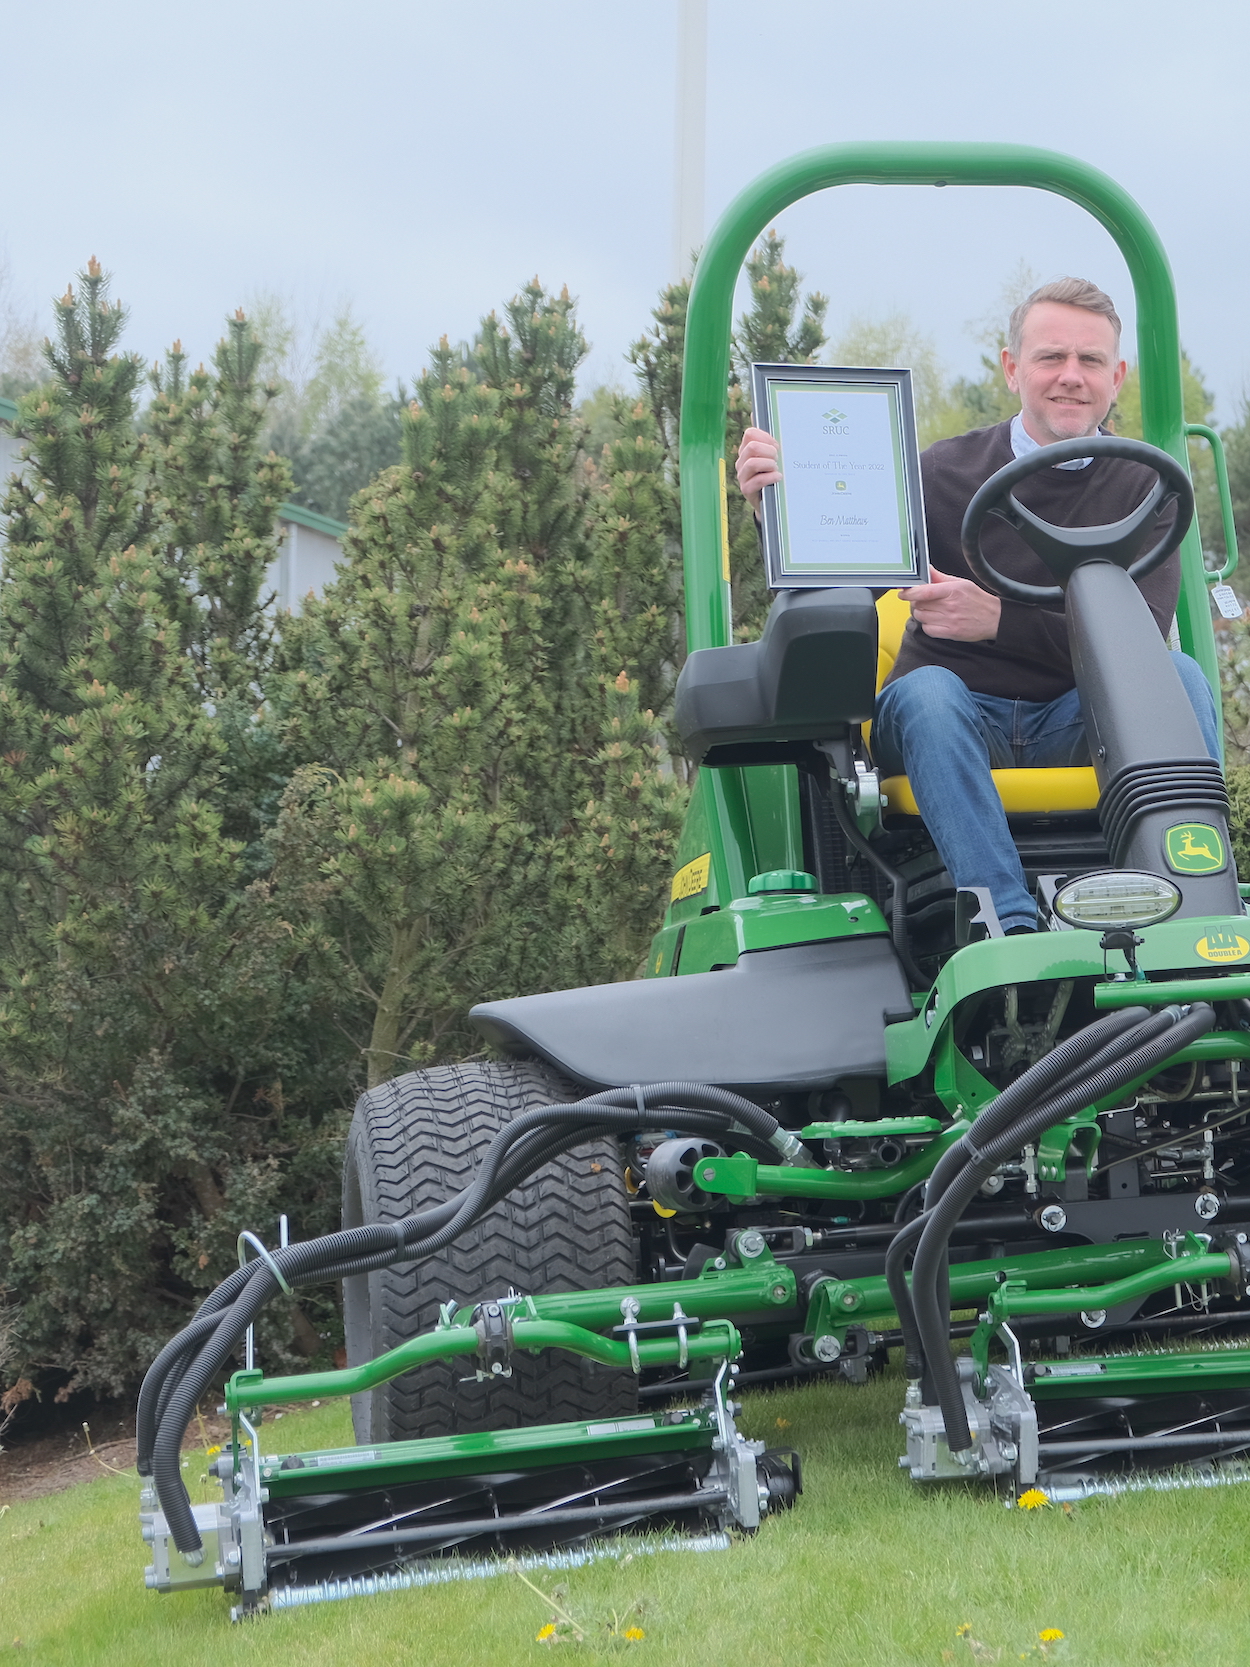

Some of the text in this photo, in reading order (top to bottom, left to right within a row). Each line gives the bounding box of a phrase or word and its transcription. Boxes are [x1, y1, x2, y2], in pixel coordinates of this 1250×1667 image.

[822, 425, 849, 435] SRUC
[793, 461, 821, 470] Student
[822, 461, 831, 470] of
[832, 461, 848, 470] The
[849, 461, 866, 470] Year
[820, 514, 869, 526] Ben Matthews
